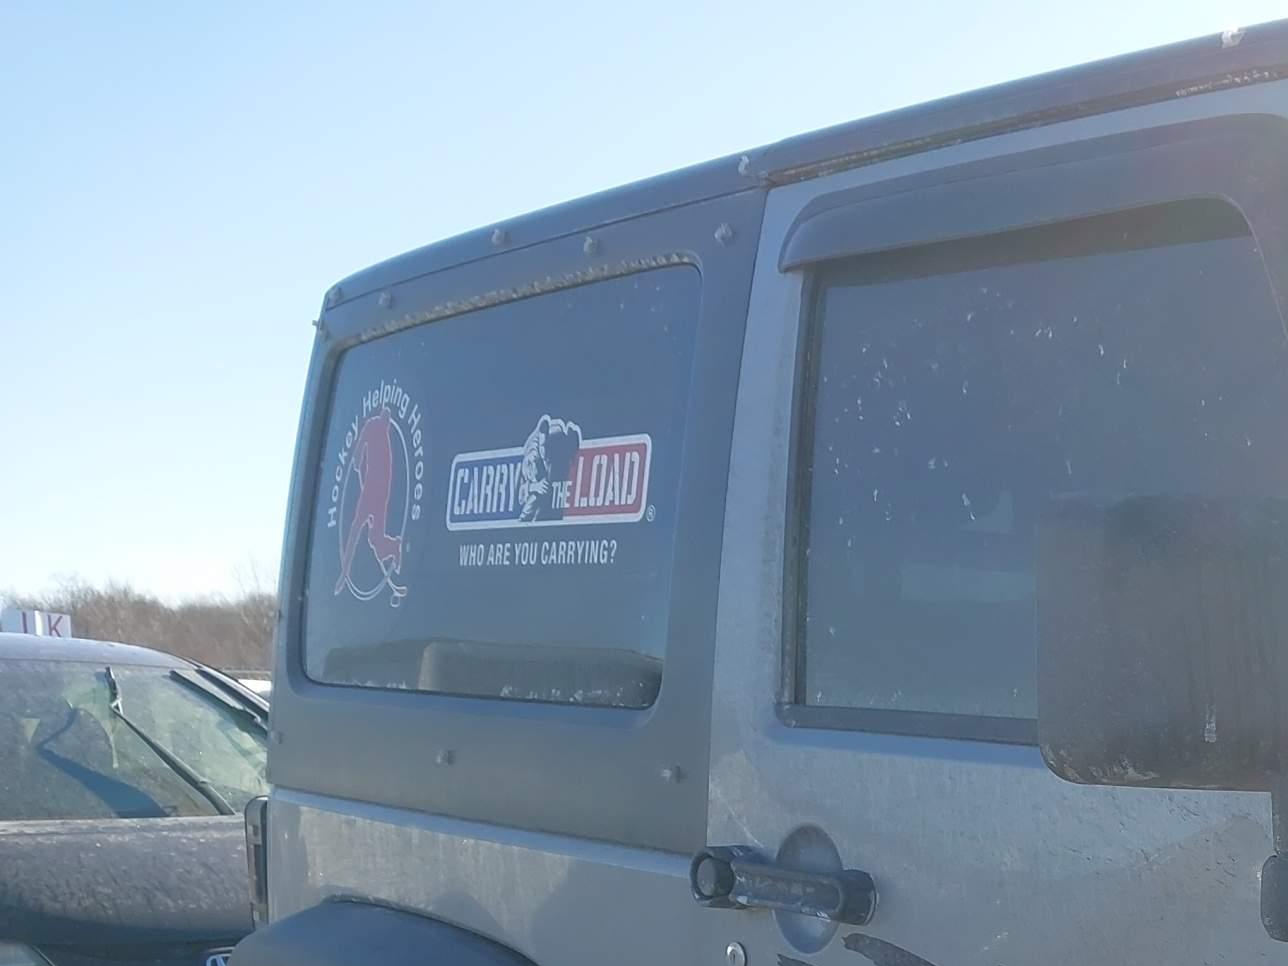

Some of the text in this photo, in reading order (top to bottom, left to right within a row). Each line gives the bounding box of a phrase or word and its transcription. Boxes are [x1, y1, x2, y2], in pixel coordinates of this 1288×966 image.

[327, 378, 424, 528] Hockey Helping Heroes
[454, 451, 640, 515] CARRY THE LOAD
[459, 540, 617, 566] WHO ARE YOU CARRYING?
